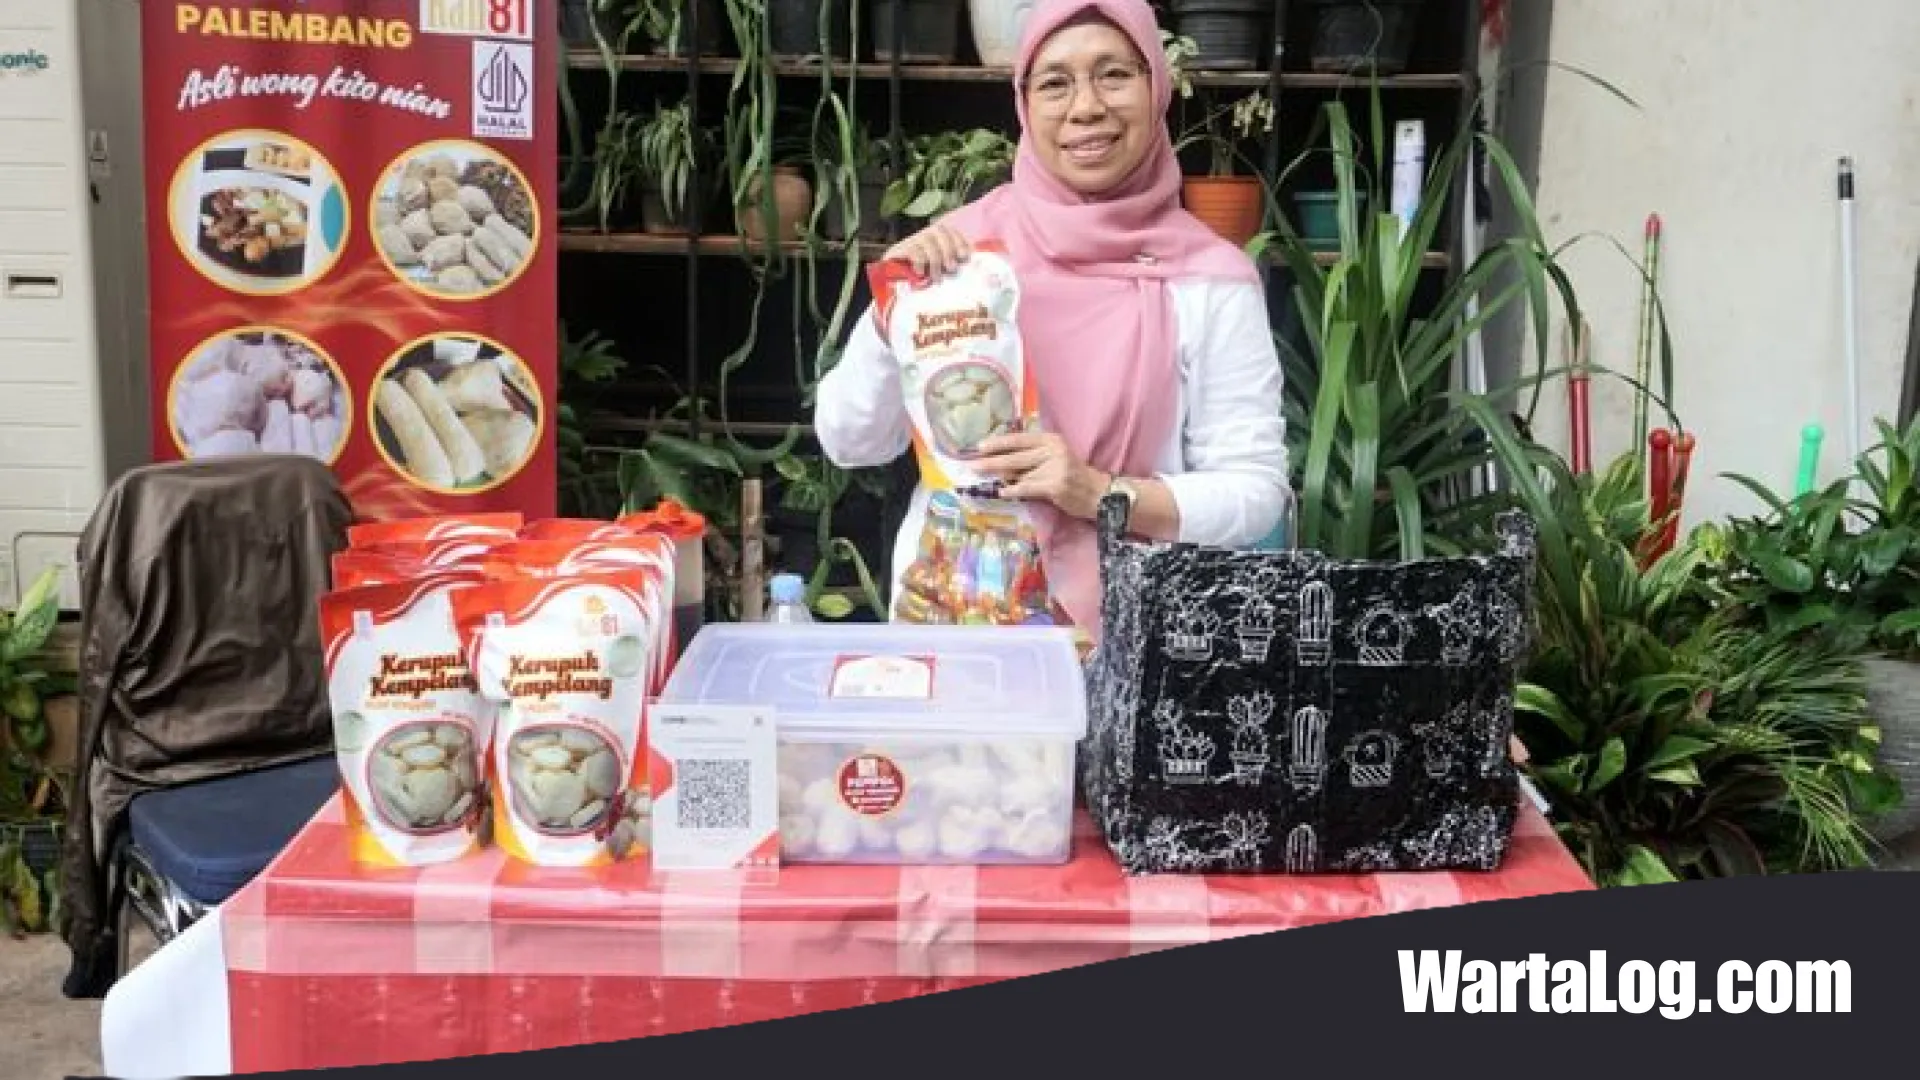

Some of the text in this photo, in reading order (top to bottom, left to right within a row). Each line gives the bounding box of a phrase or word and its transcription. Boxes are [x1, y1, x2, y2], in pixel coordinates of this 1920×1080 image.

[175, 4, 412, 48] PALEMBANG
[176, 63, 451, 119] Asli wong kito nian
